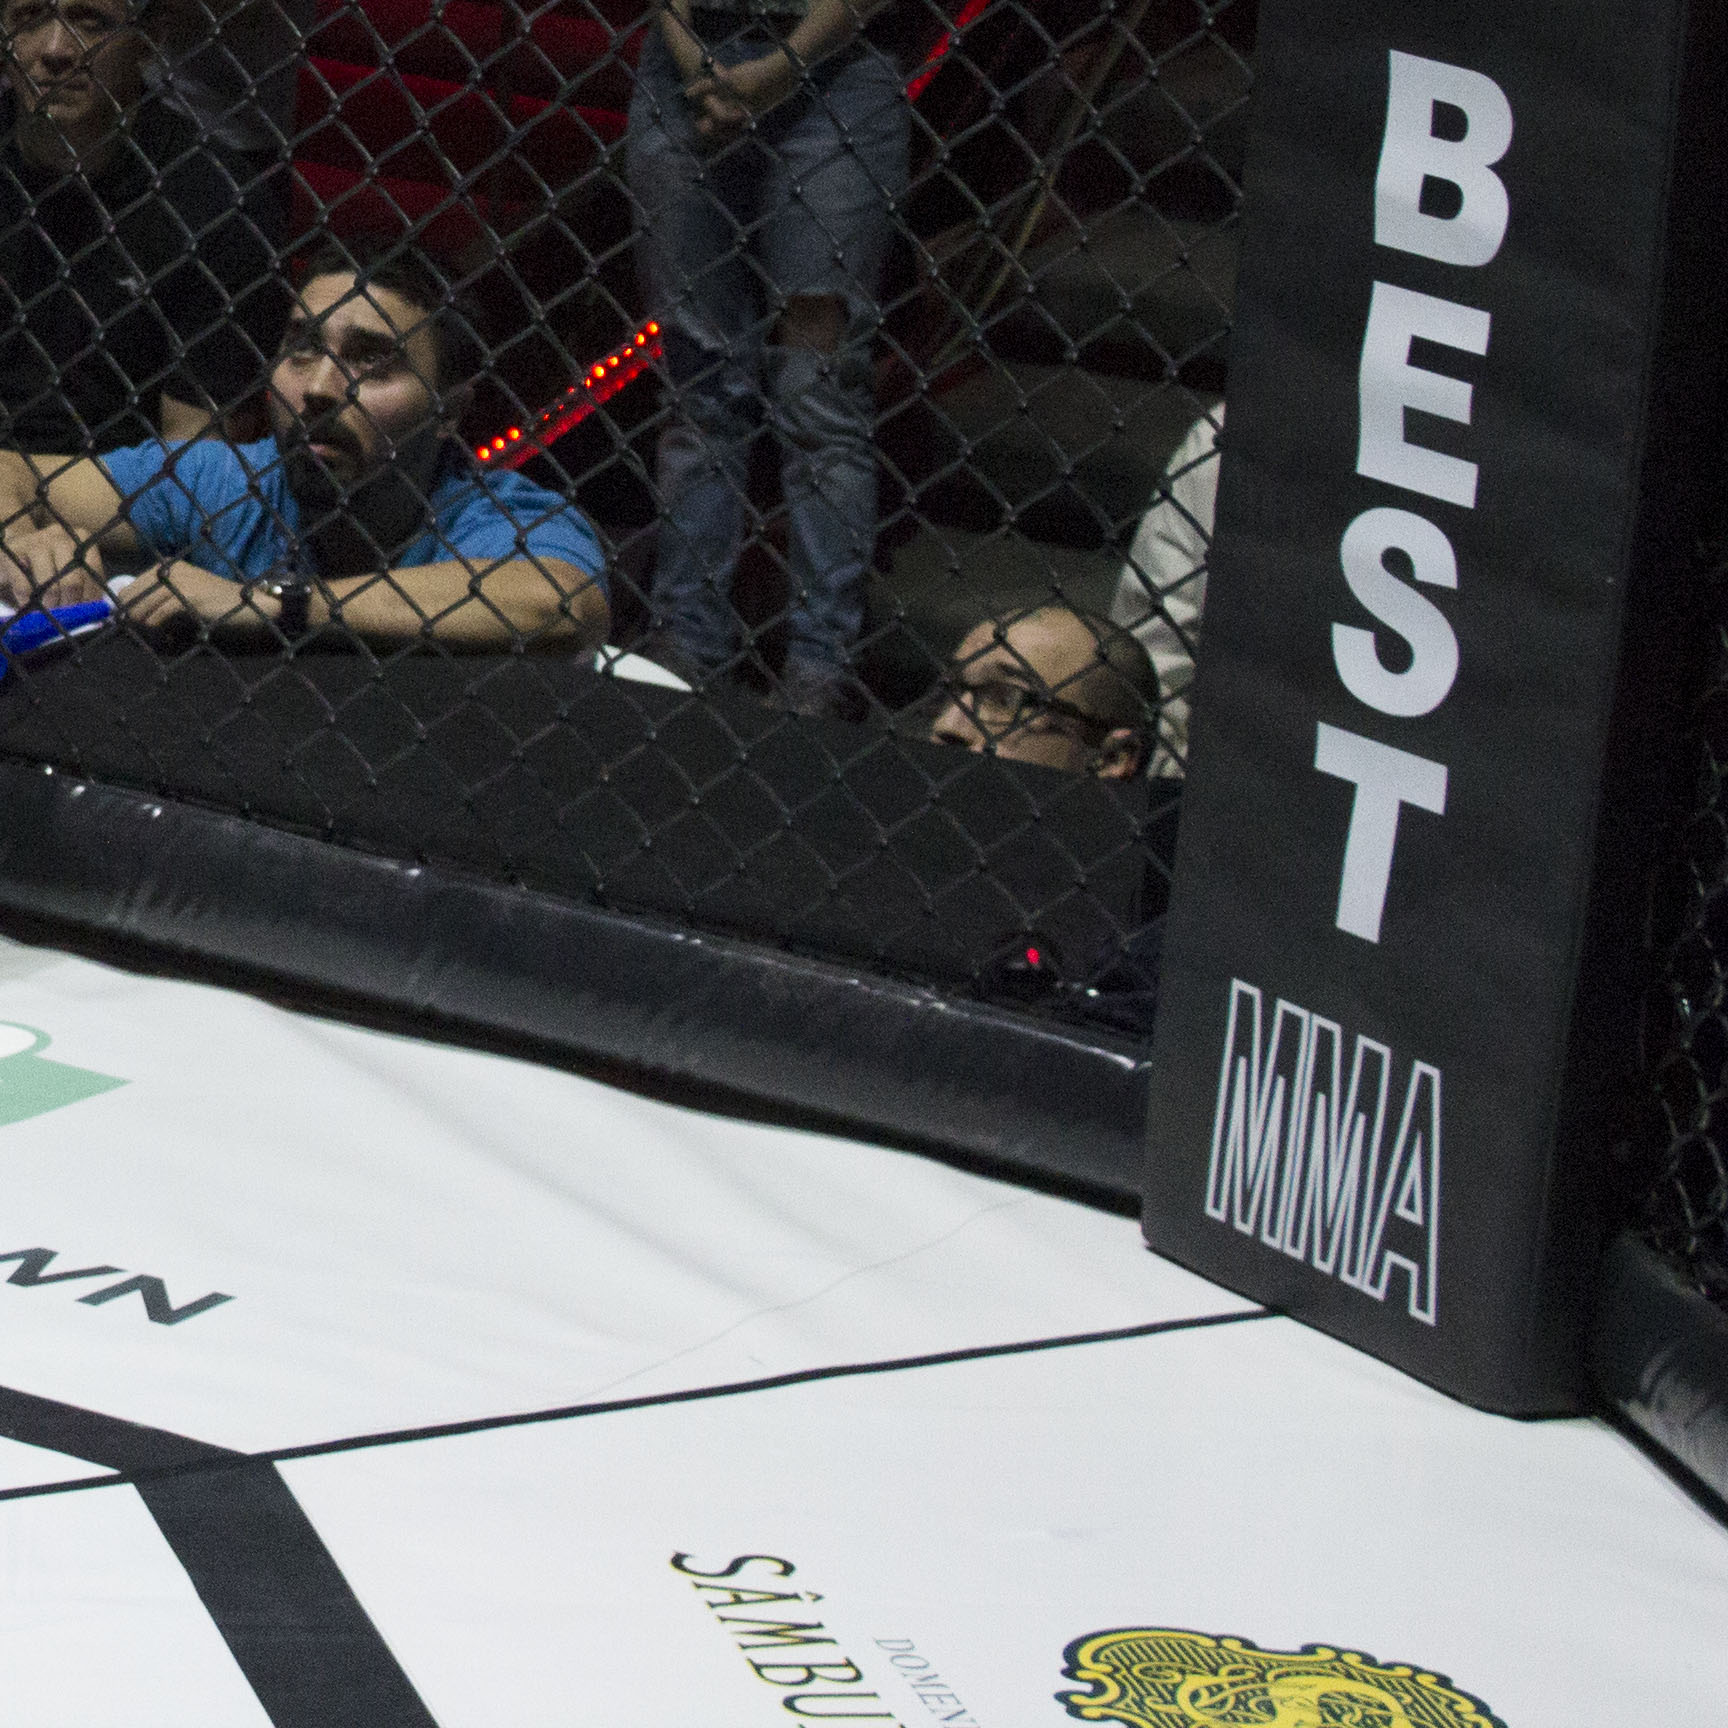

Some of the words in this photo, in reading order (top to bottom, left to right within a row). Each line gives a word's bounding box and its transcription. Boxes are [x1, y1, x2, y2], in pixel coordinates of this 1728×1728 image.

[1314, 47, 1514, 944] BEST
[1204, 977, 1442, 1327] MMA
[669, 1549, 912, 1728] SÂMBU
